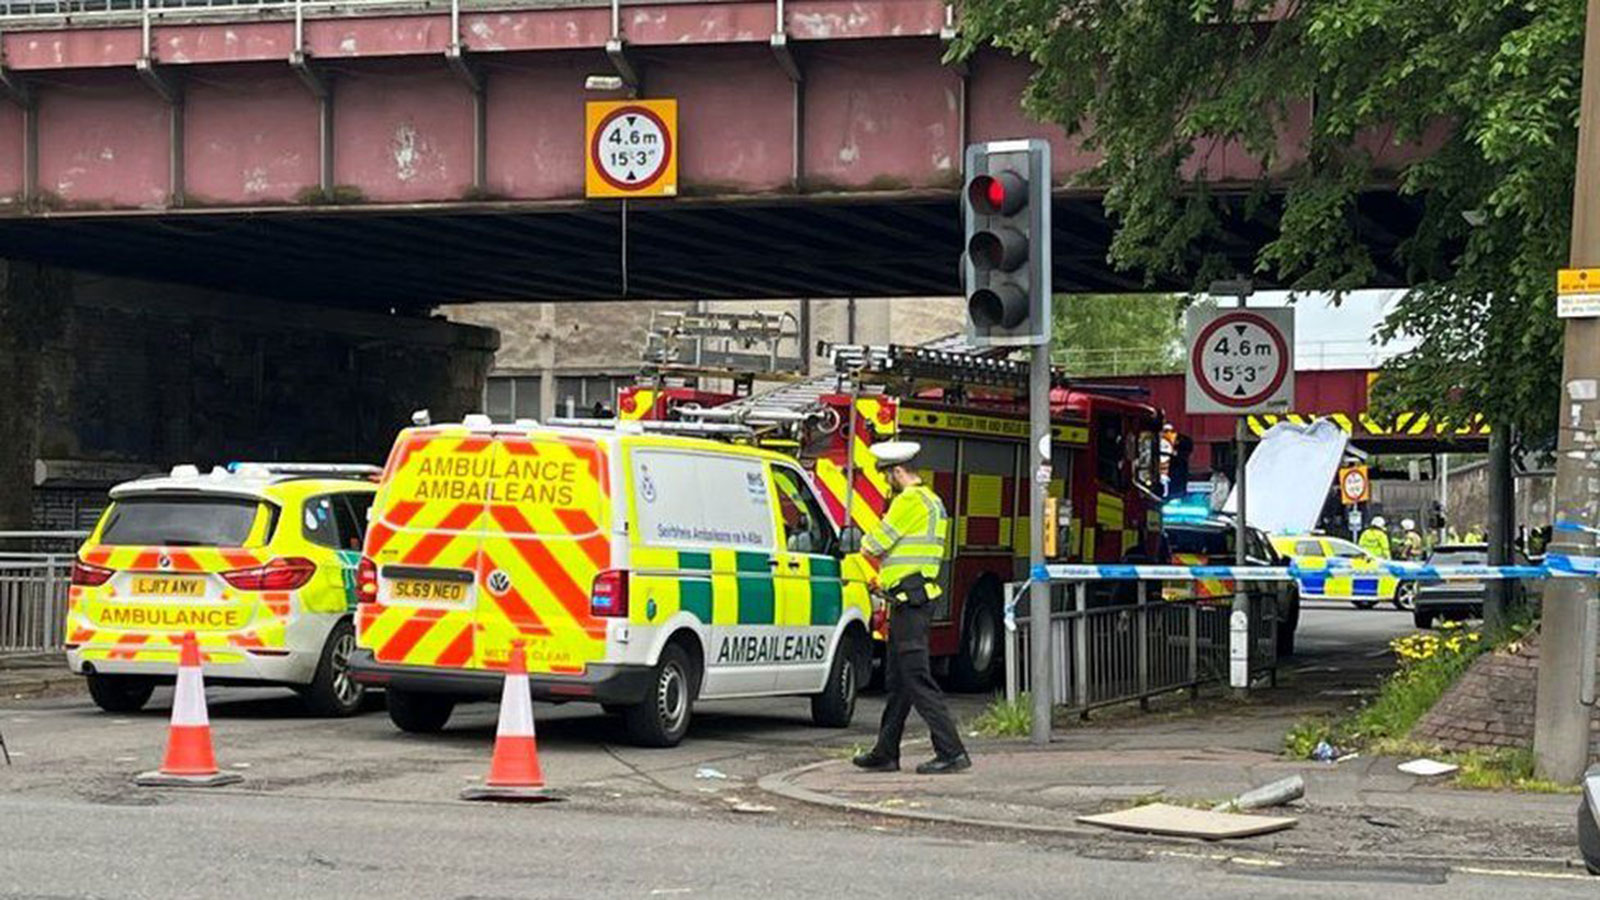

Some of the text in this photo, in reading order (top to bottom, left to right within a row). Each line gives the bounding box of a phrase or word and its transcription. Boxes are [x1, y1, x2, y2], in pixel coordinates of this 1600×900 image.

[417, 456, 576, 483] AMBULANCE
[414, 479, 574, 506] AMBAILEANS
[395, 582, 431, 598] SL69
[99, 608, 239, 627] AMBULANCE
[717, 634, 827, 662] AMBAILEANS
